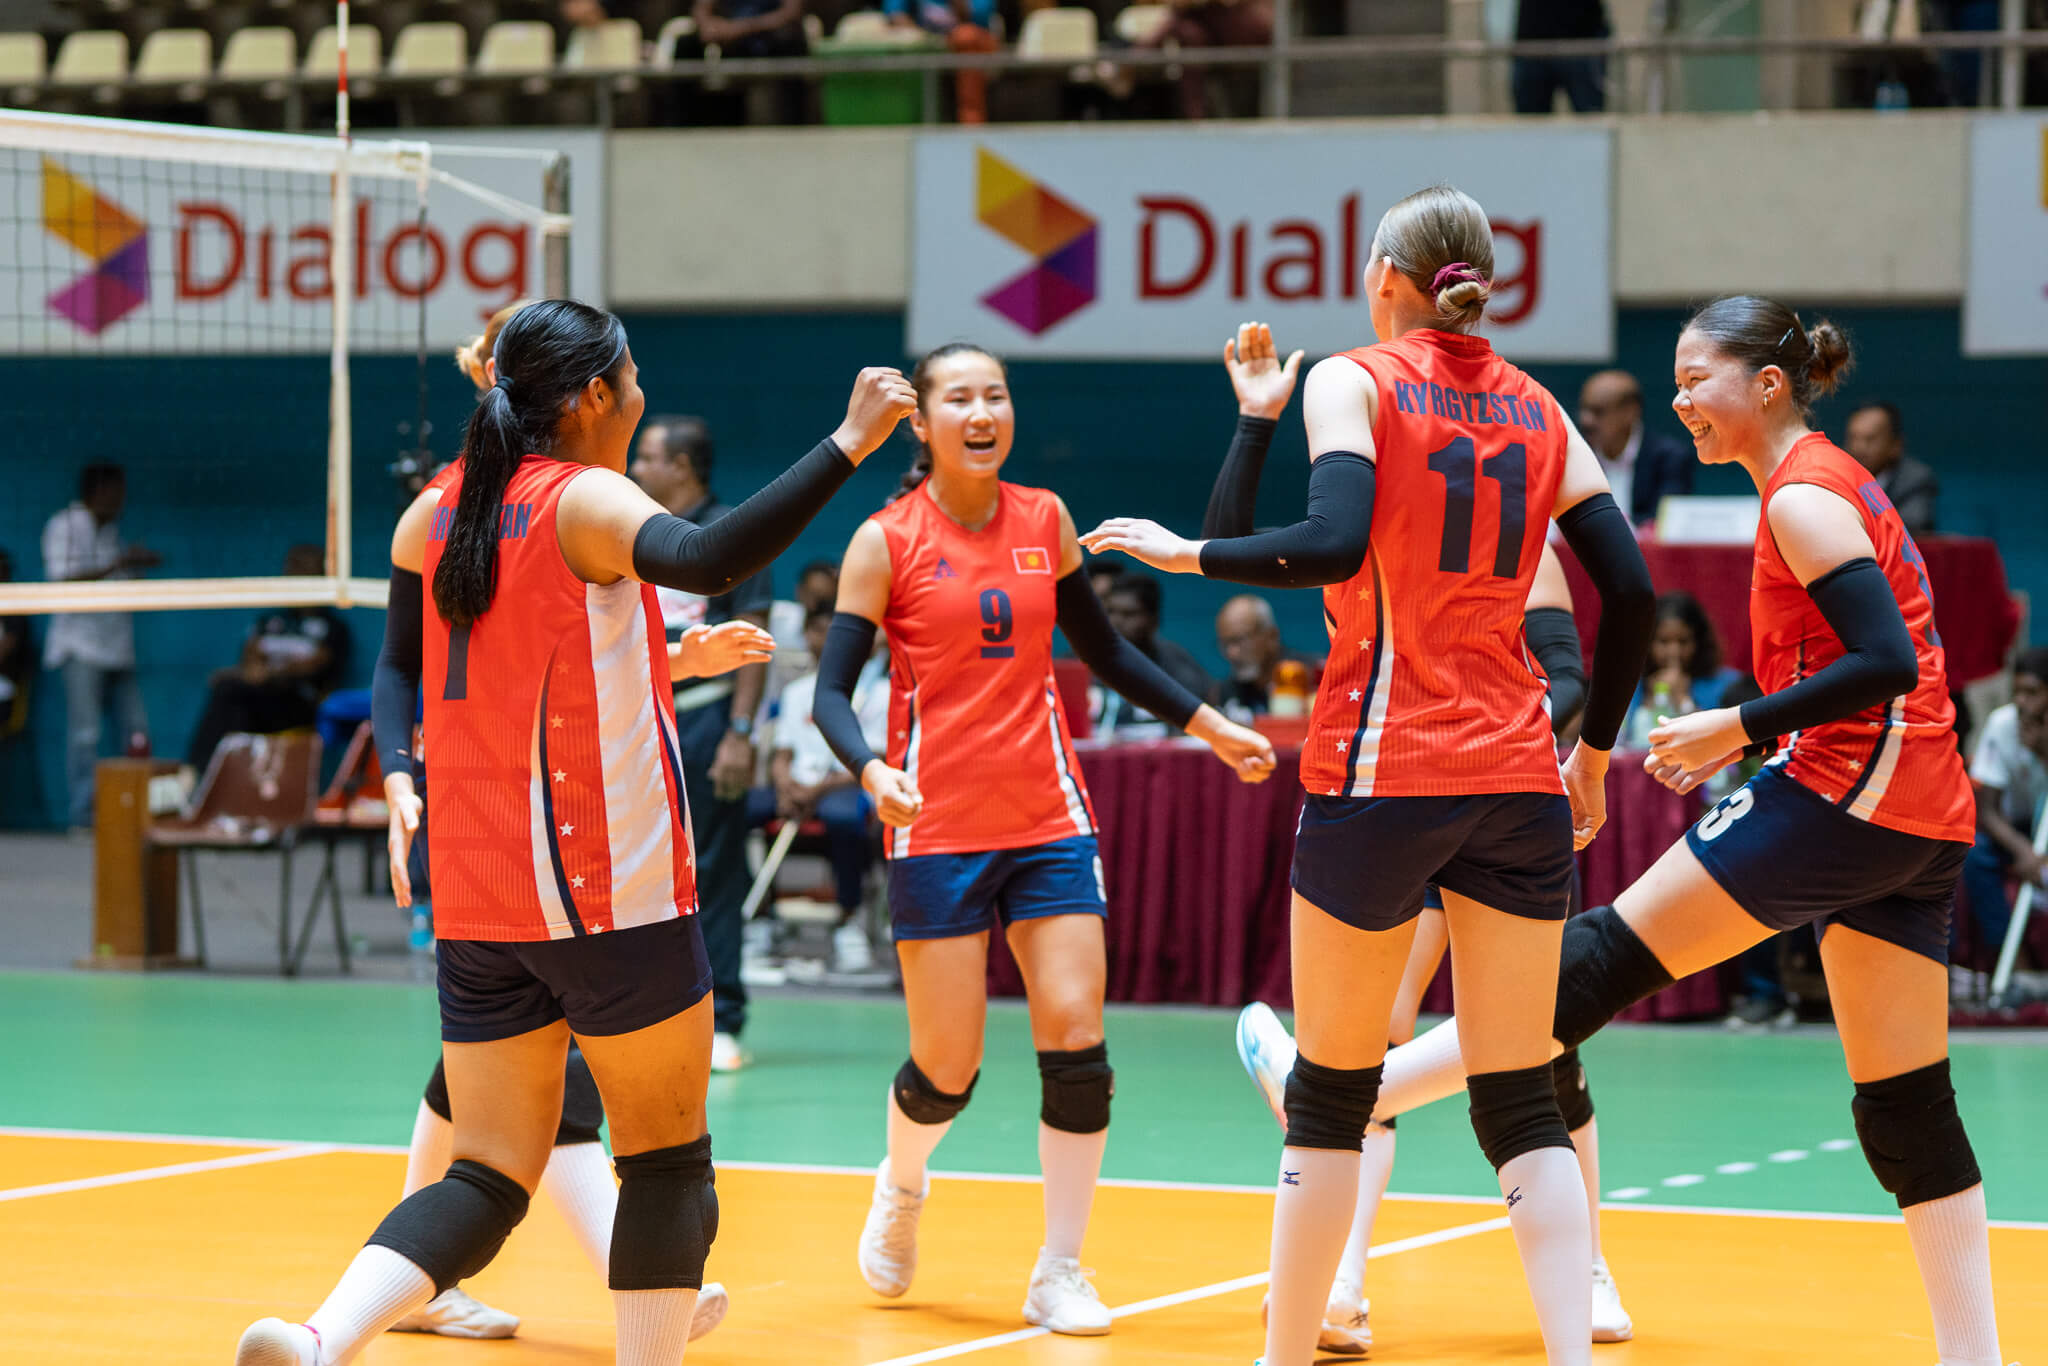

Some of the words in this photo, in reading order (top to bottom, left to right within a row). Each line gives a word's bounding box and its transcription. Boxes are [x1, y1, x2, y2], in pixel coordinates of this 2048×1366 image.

[174, 195, 530, 323] Dialog
[1135, 190, 1543, 330] Dialg
[1394, 380, 1547, 432] KYRGYZSTAN
[1427, 436, 1527, 579] 11
[979, 588, 1013, 643] 9
